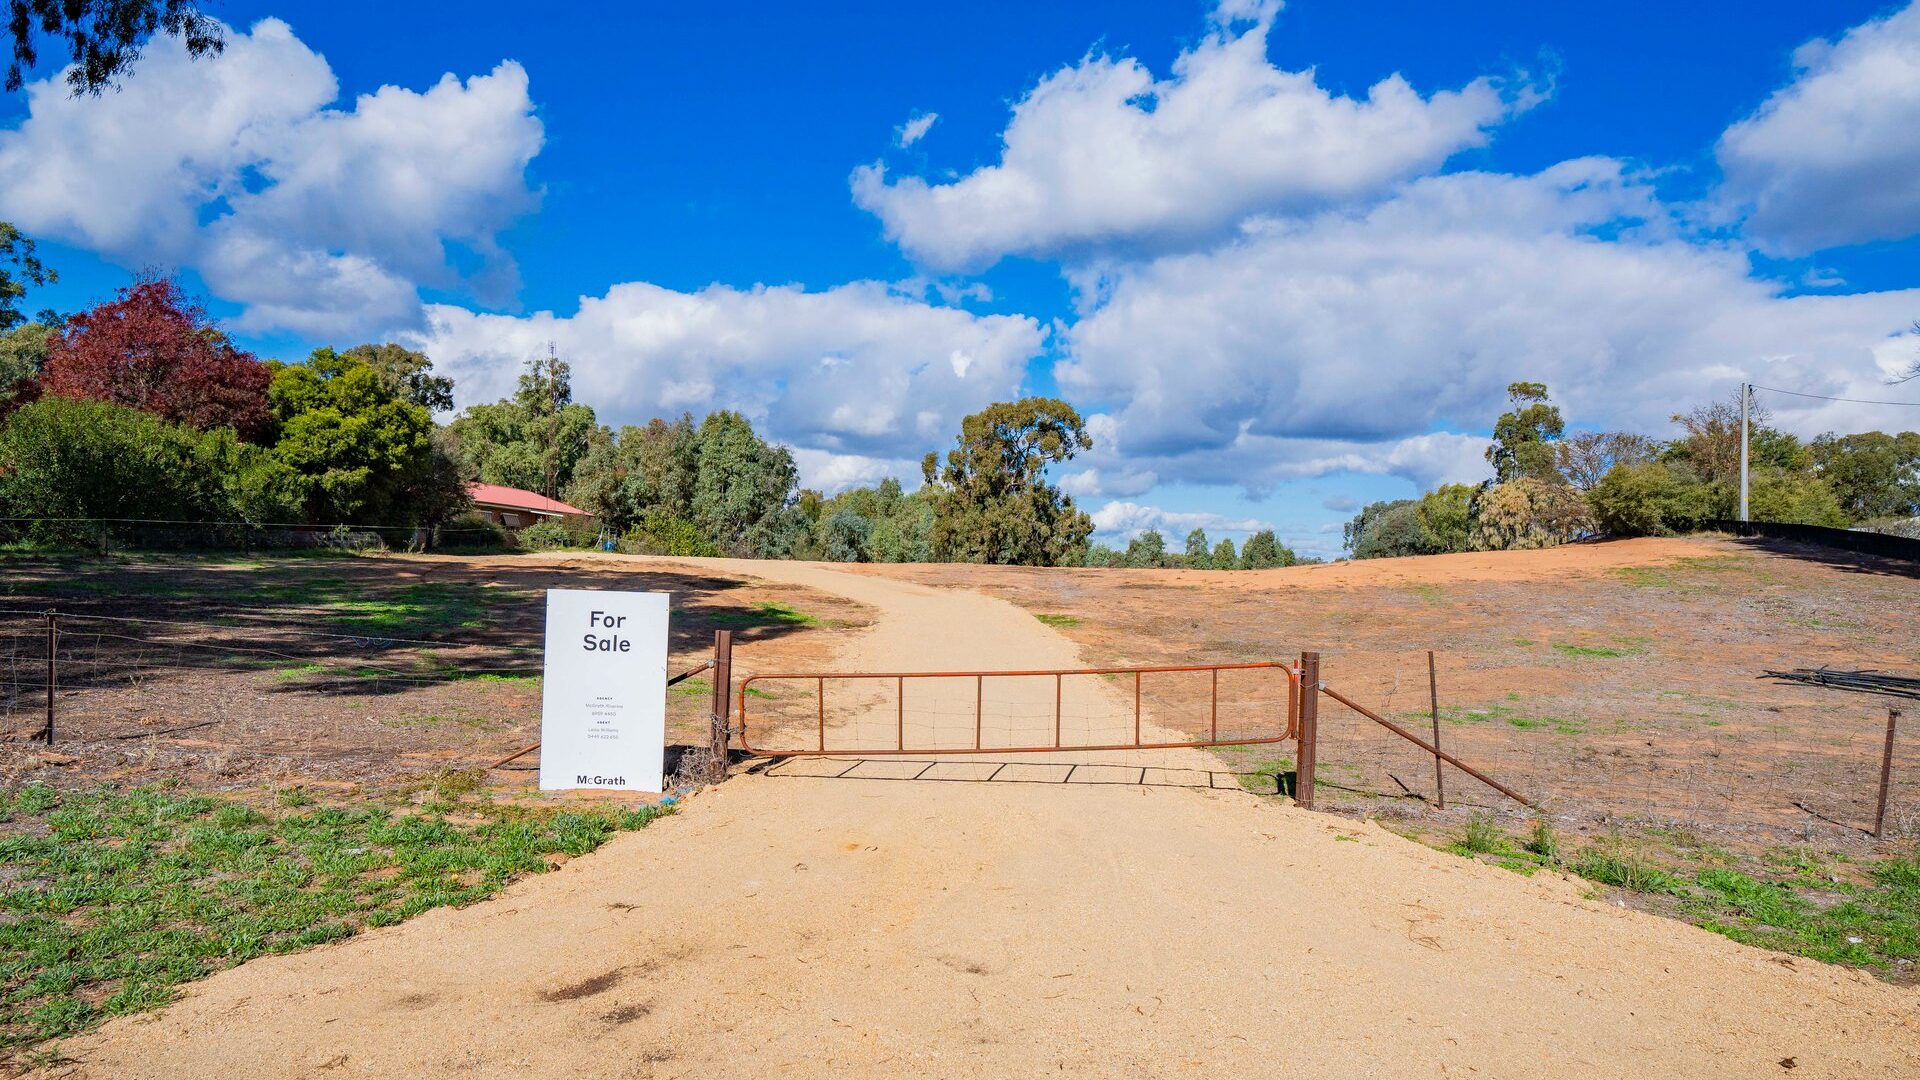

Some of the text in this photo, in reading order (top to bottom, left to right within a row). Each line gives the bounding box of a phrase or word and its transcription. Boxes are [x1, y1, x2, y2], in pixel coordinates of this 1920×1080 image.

[590, 610, 627, 629] For
[583, 633, 631, 653] Sale
[576, 775, 626, 786] McGrath
